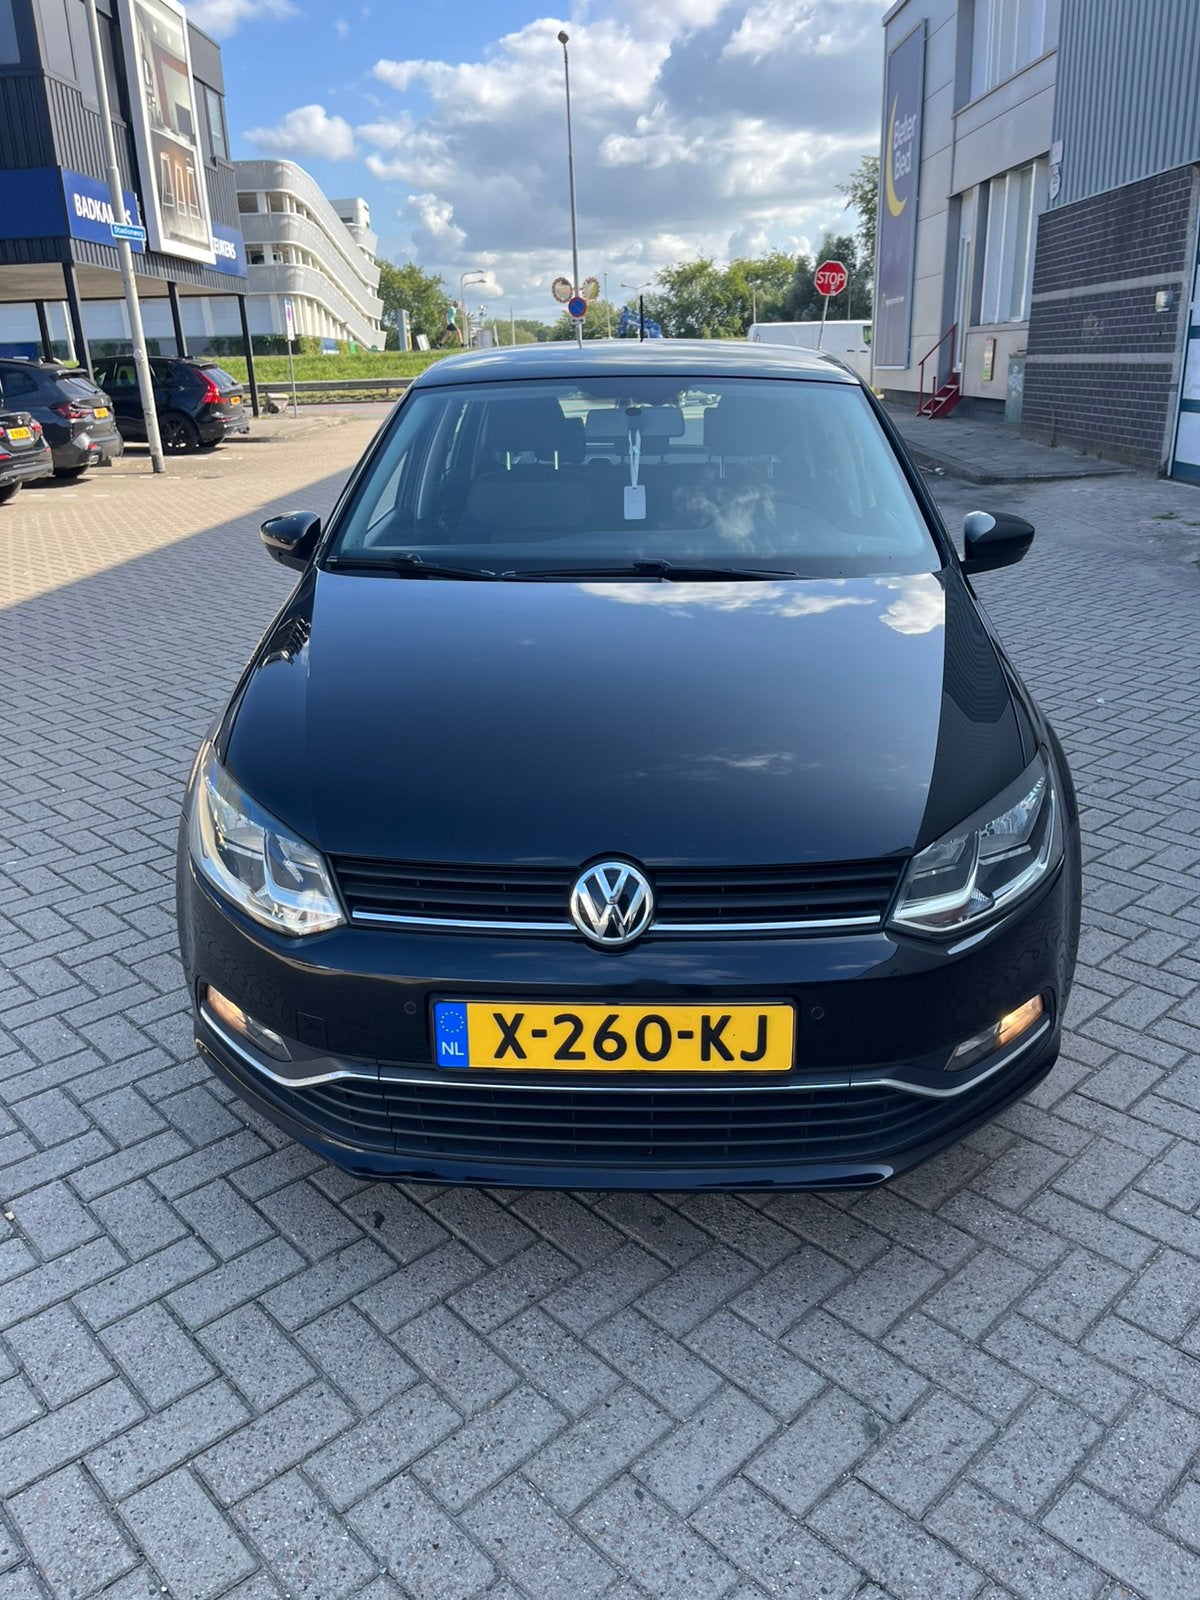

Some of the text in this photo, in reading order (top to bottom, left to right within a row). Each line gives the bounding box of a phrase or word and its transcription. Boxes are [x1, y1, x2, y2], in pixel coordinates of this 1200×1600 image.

[893, 113, 917, 150] Beter
[894, 142, 912, 181] Bed
[212, 237, 237, 261] EUKENS
[816, 271, 845, 285] STOP
[441, 1041, 464, 1056] NL
[492, 1012, 768, 1062] X-260-KJ
